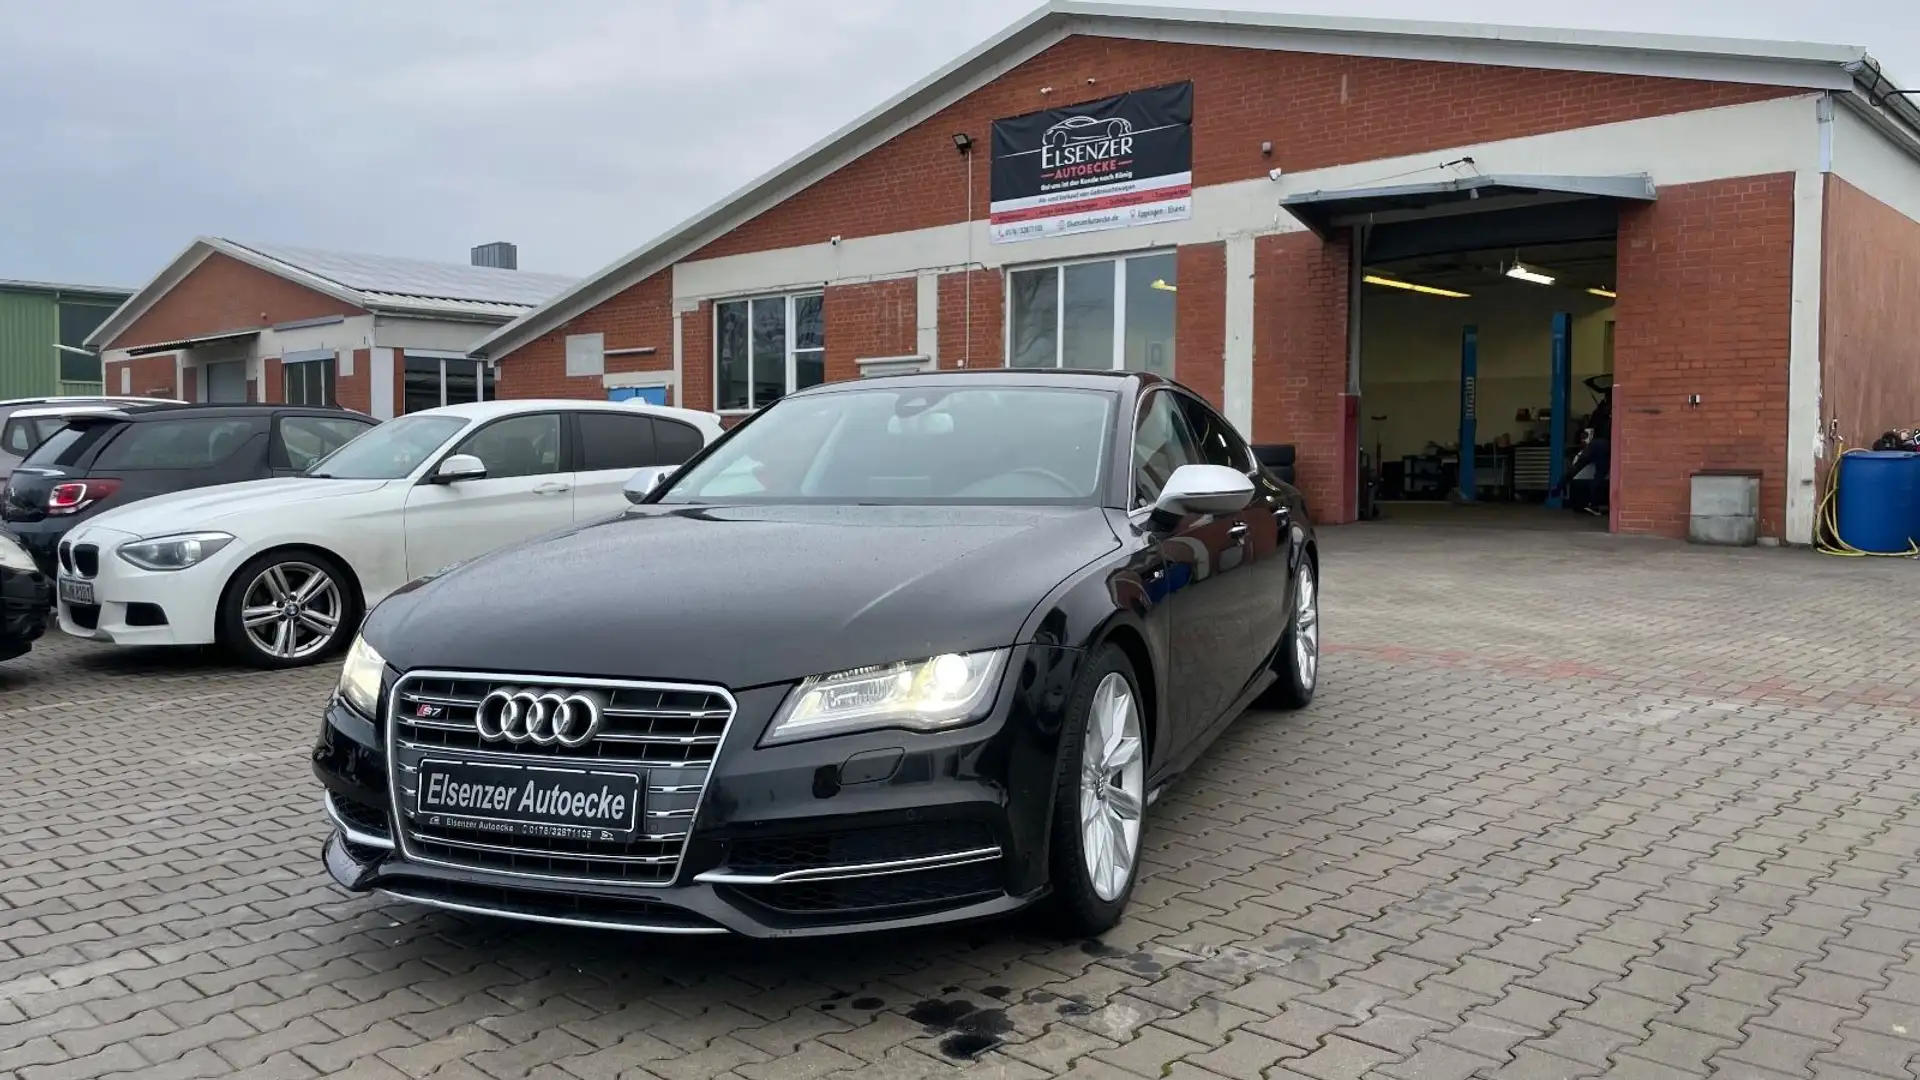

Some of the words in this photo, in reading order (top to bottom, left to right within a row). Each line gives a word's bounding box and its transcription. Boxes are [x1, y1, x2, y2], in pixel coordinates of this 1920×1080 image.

[1042, 137, 1133, 169] ELSENZER
[1054, 160, 1117, 179] AUTOECKE
[1115, 170, 1132, 180] König
[420, 704, 442, 717] S7
[427, 772, 518, 812] Elsenzer
[517, 779, 625, 820] Autoecke
[446, 817, 477, 829] Elsenzer
[479, 820, 514, 833] Autoecke
